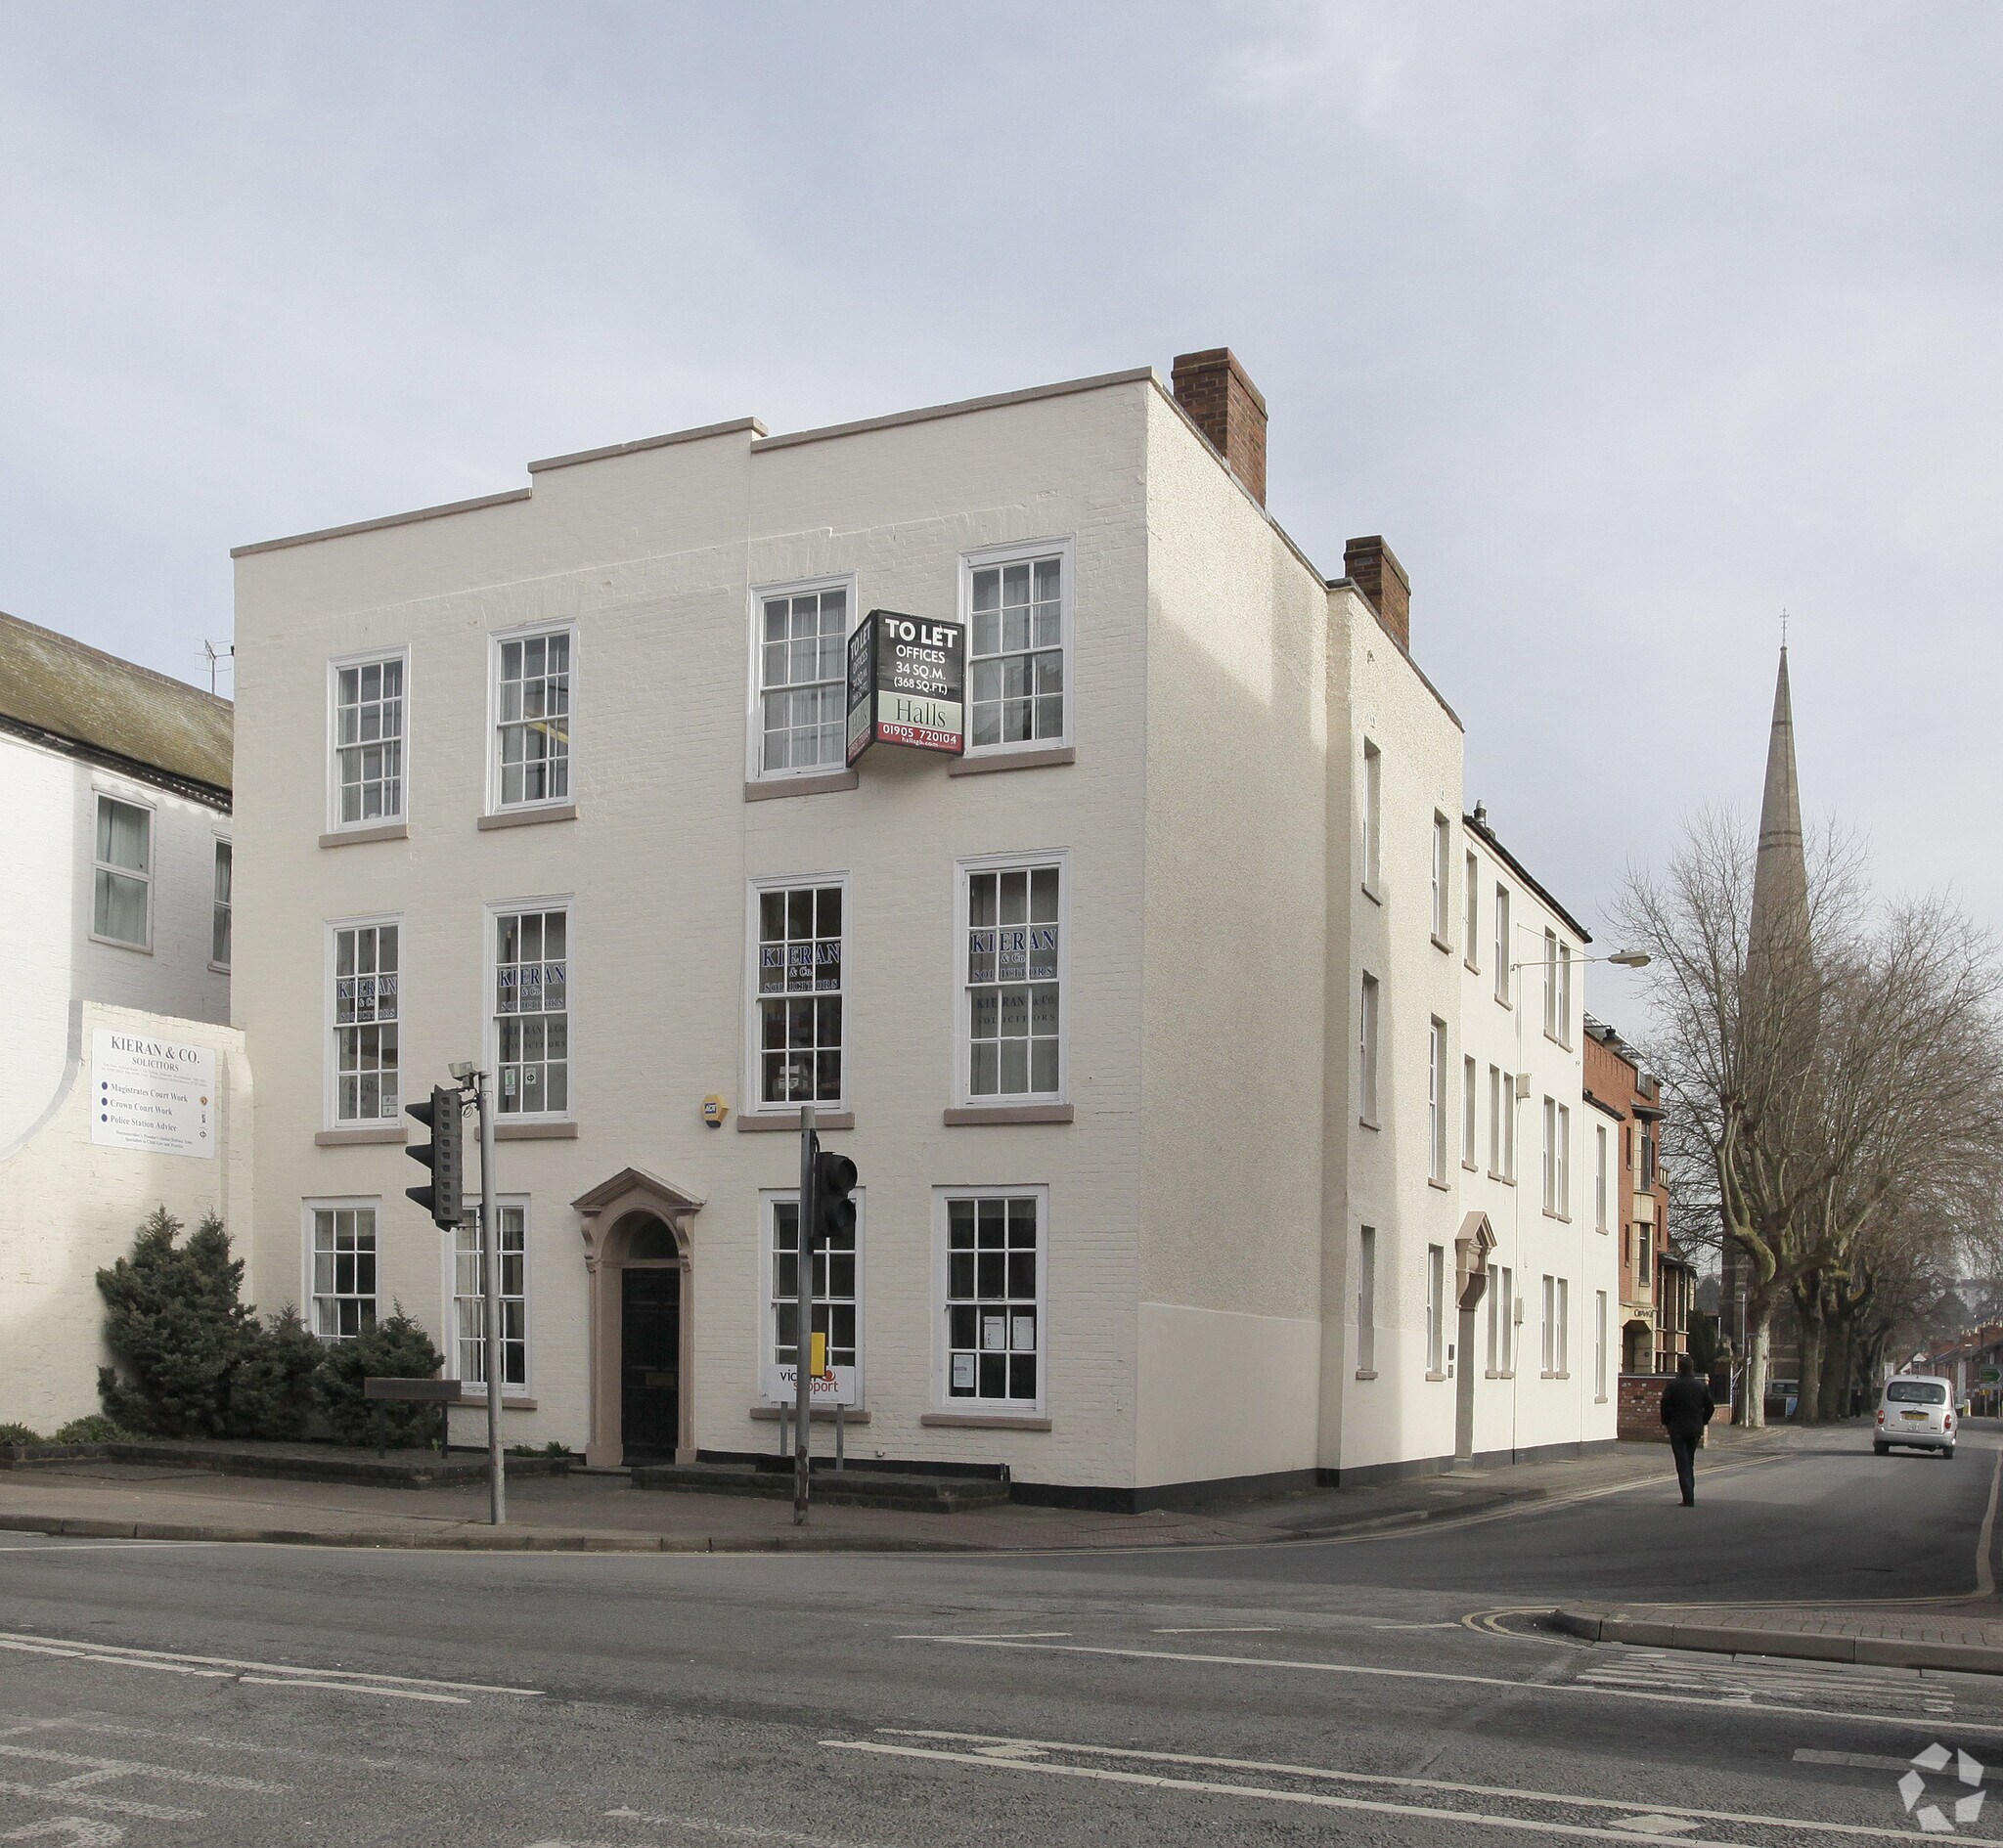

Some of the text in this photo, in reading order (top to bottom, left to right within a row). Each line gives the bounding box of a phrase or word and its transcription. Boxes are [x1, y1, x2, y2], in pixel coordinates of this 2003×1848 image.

[851, 620, 871, 660] TO LET
[885, 618, 957, 648] TO LET
[896, 644, 946, 664] OFFICES
[894, 676, 914, 688] (368
[896, 662, 947, 681] 34 SQ.M.
[896, 698, 946, 727] Halls
[883, 724, 957, 745] 01905 720104
[971, 929, 1057, 953] KIERAN
[762, 944, 841, 967] KIERAN
[1001, 953, 1009, 964] &
[499, 964, 565, 988] KIERAN
[789, 967, 798, 978] &
[338, 977, 398, 999] KIERAN
[111, 1035, 200, 1064] KIERAN & CO.
[132, 1057, 179, 1072] SOLICITORS
[111, 1082, 188, 1103] Magistrates Court Work
[111, 1099, 173, 1116] Crown Court Work
[111, 1115, 177, 1131] Police Station Advice
[793, 1381, 838, 1394] sport
